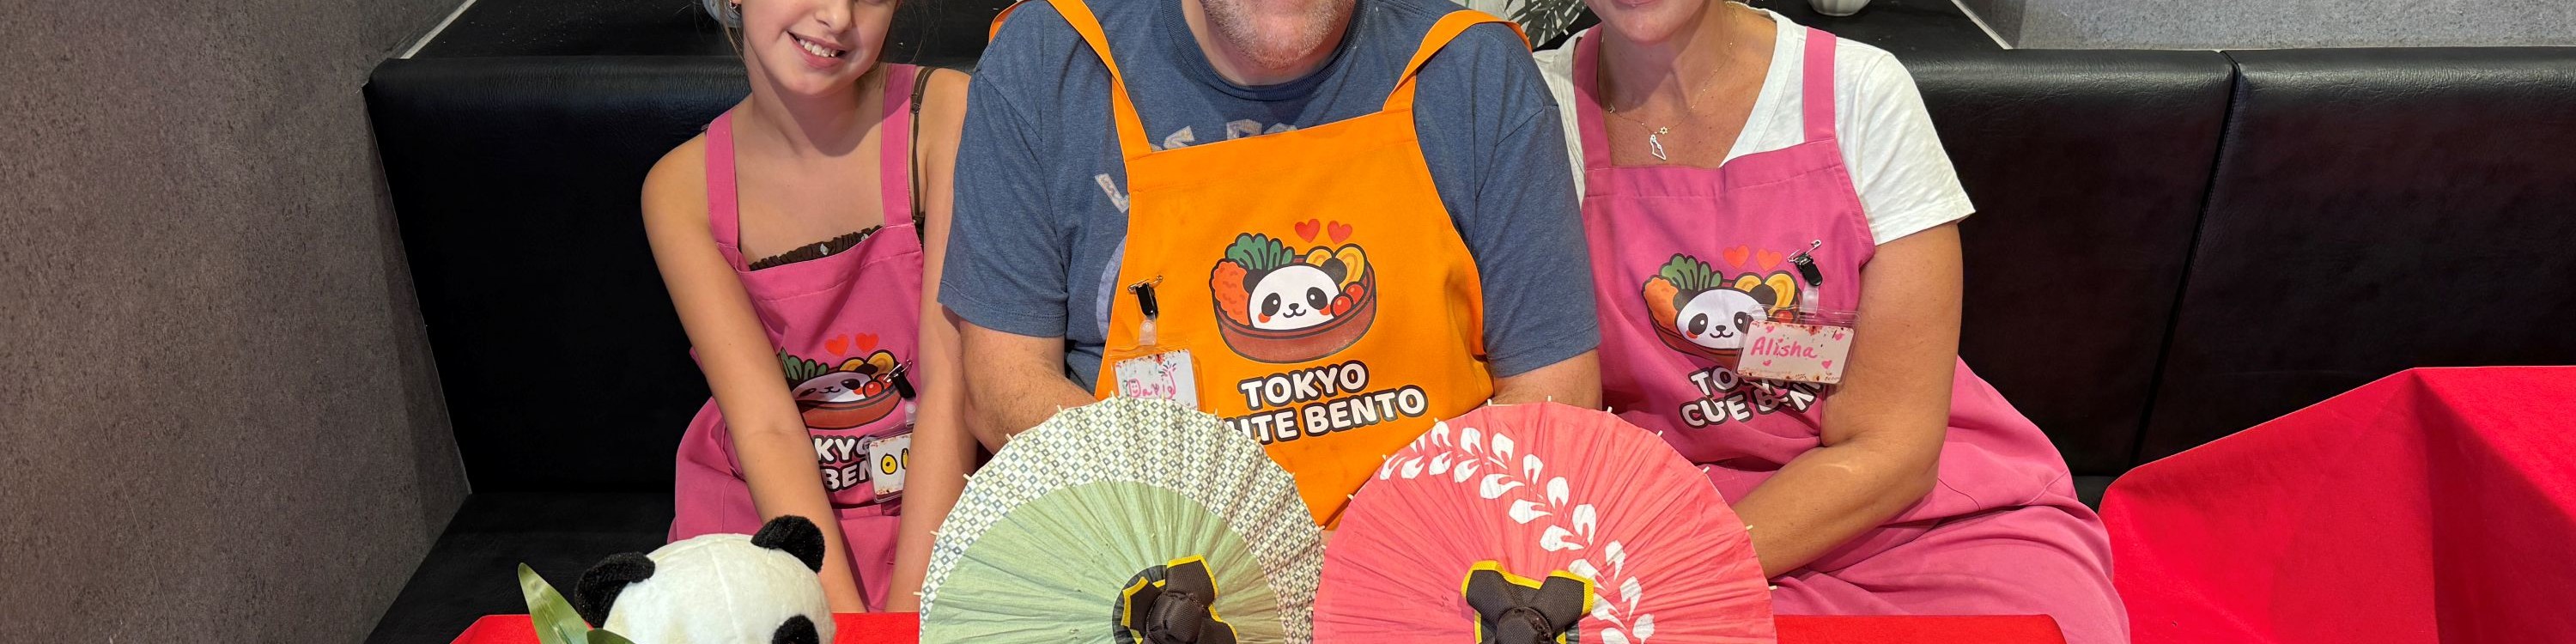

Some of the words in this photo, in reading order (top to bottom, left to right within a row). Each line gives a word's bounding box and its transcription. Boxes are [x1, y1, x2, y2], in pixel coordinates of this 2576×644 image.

[1750, 336, 1818, 359] Alisha
[1239, 361, 1368, 409] TOKYO
[1225, 409, 1299, 443] UTE
[1303, 386, 1426, 435] BENTO
